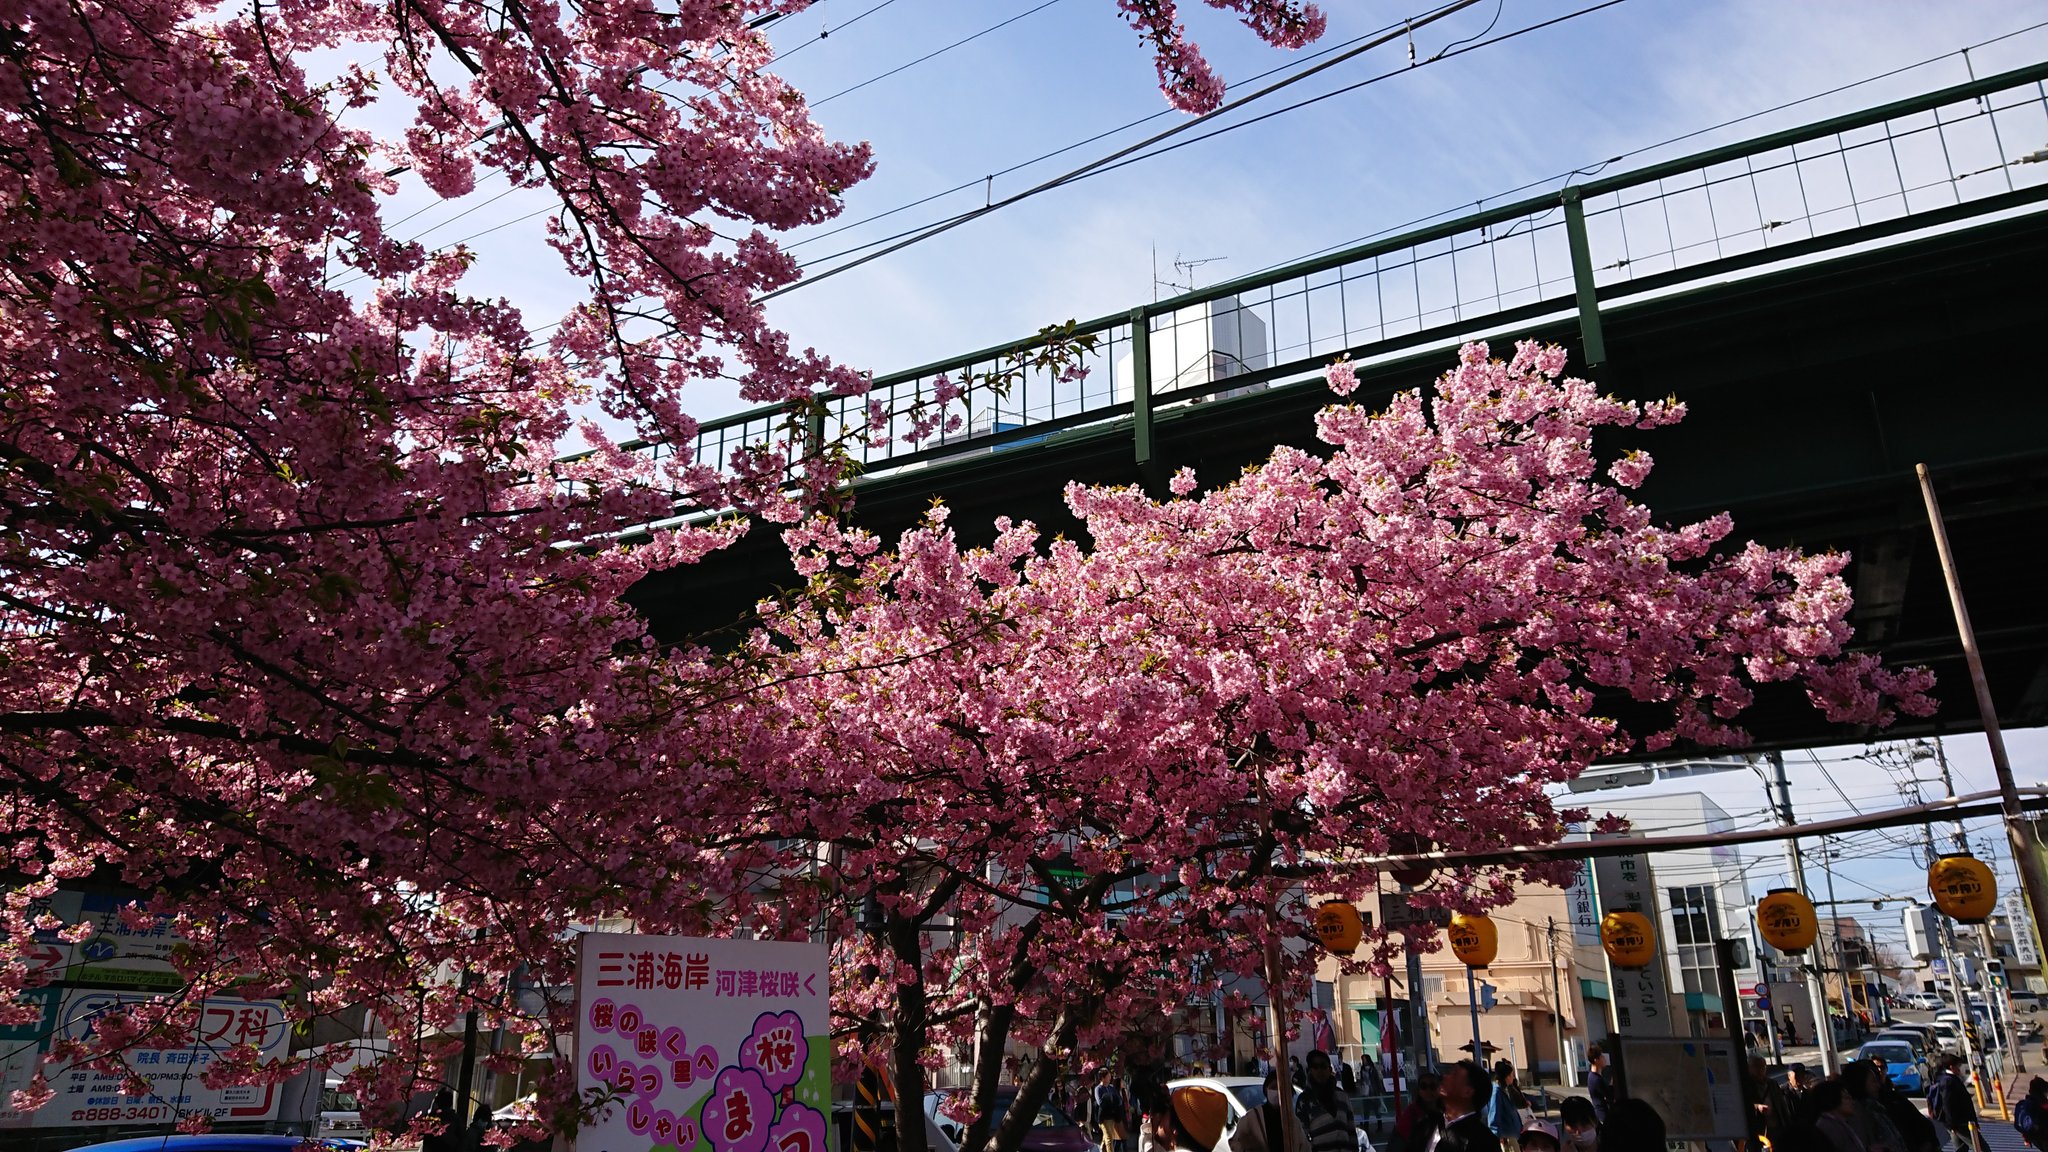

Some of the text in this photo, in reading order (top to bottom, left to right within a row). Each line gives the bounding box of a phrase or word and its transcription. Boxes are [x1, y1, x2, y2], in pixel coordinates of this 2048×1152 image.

[597, 950, 710, 990] 三浦海岸
[715, 969, 817, 998] 河津桜咲く
[85, 1106, 168, 1121] 888-3401
